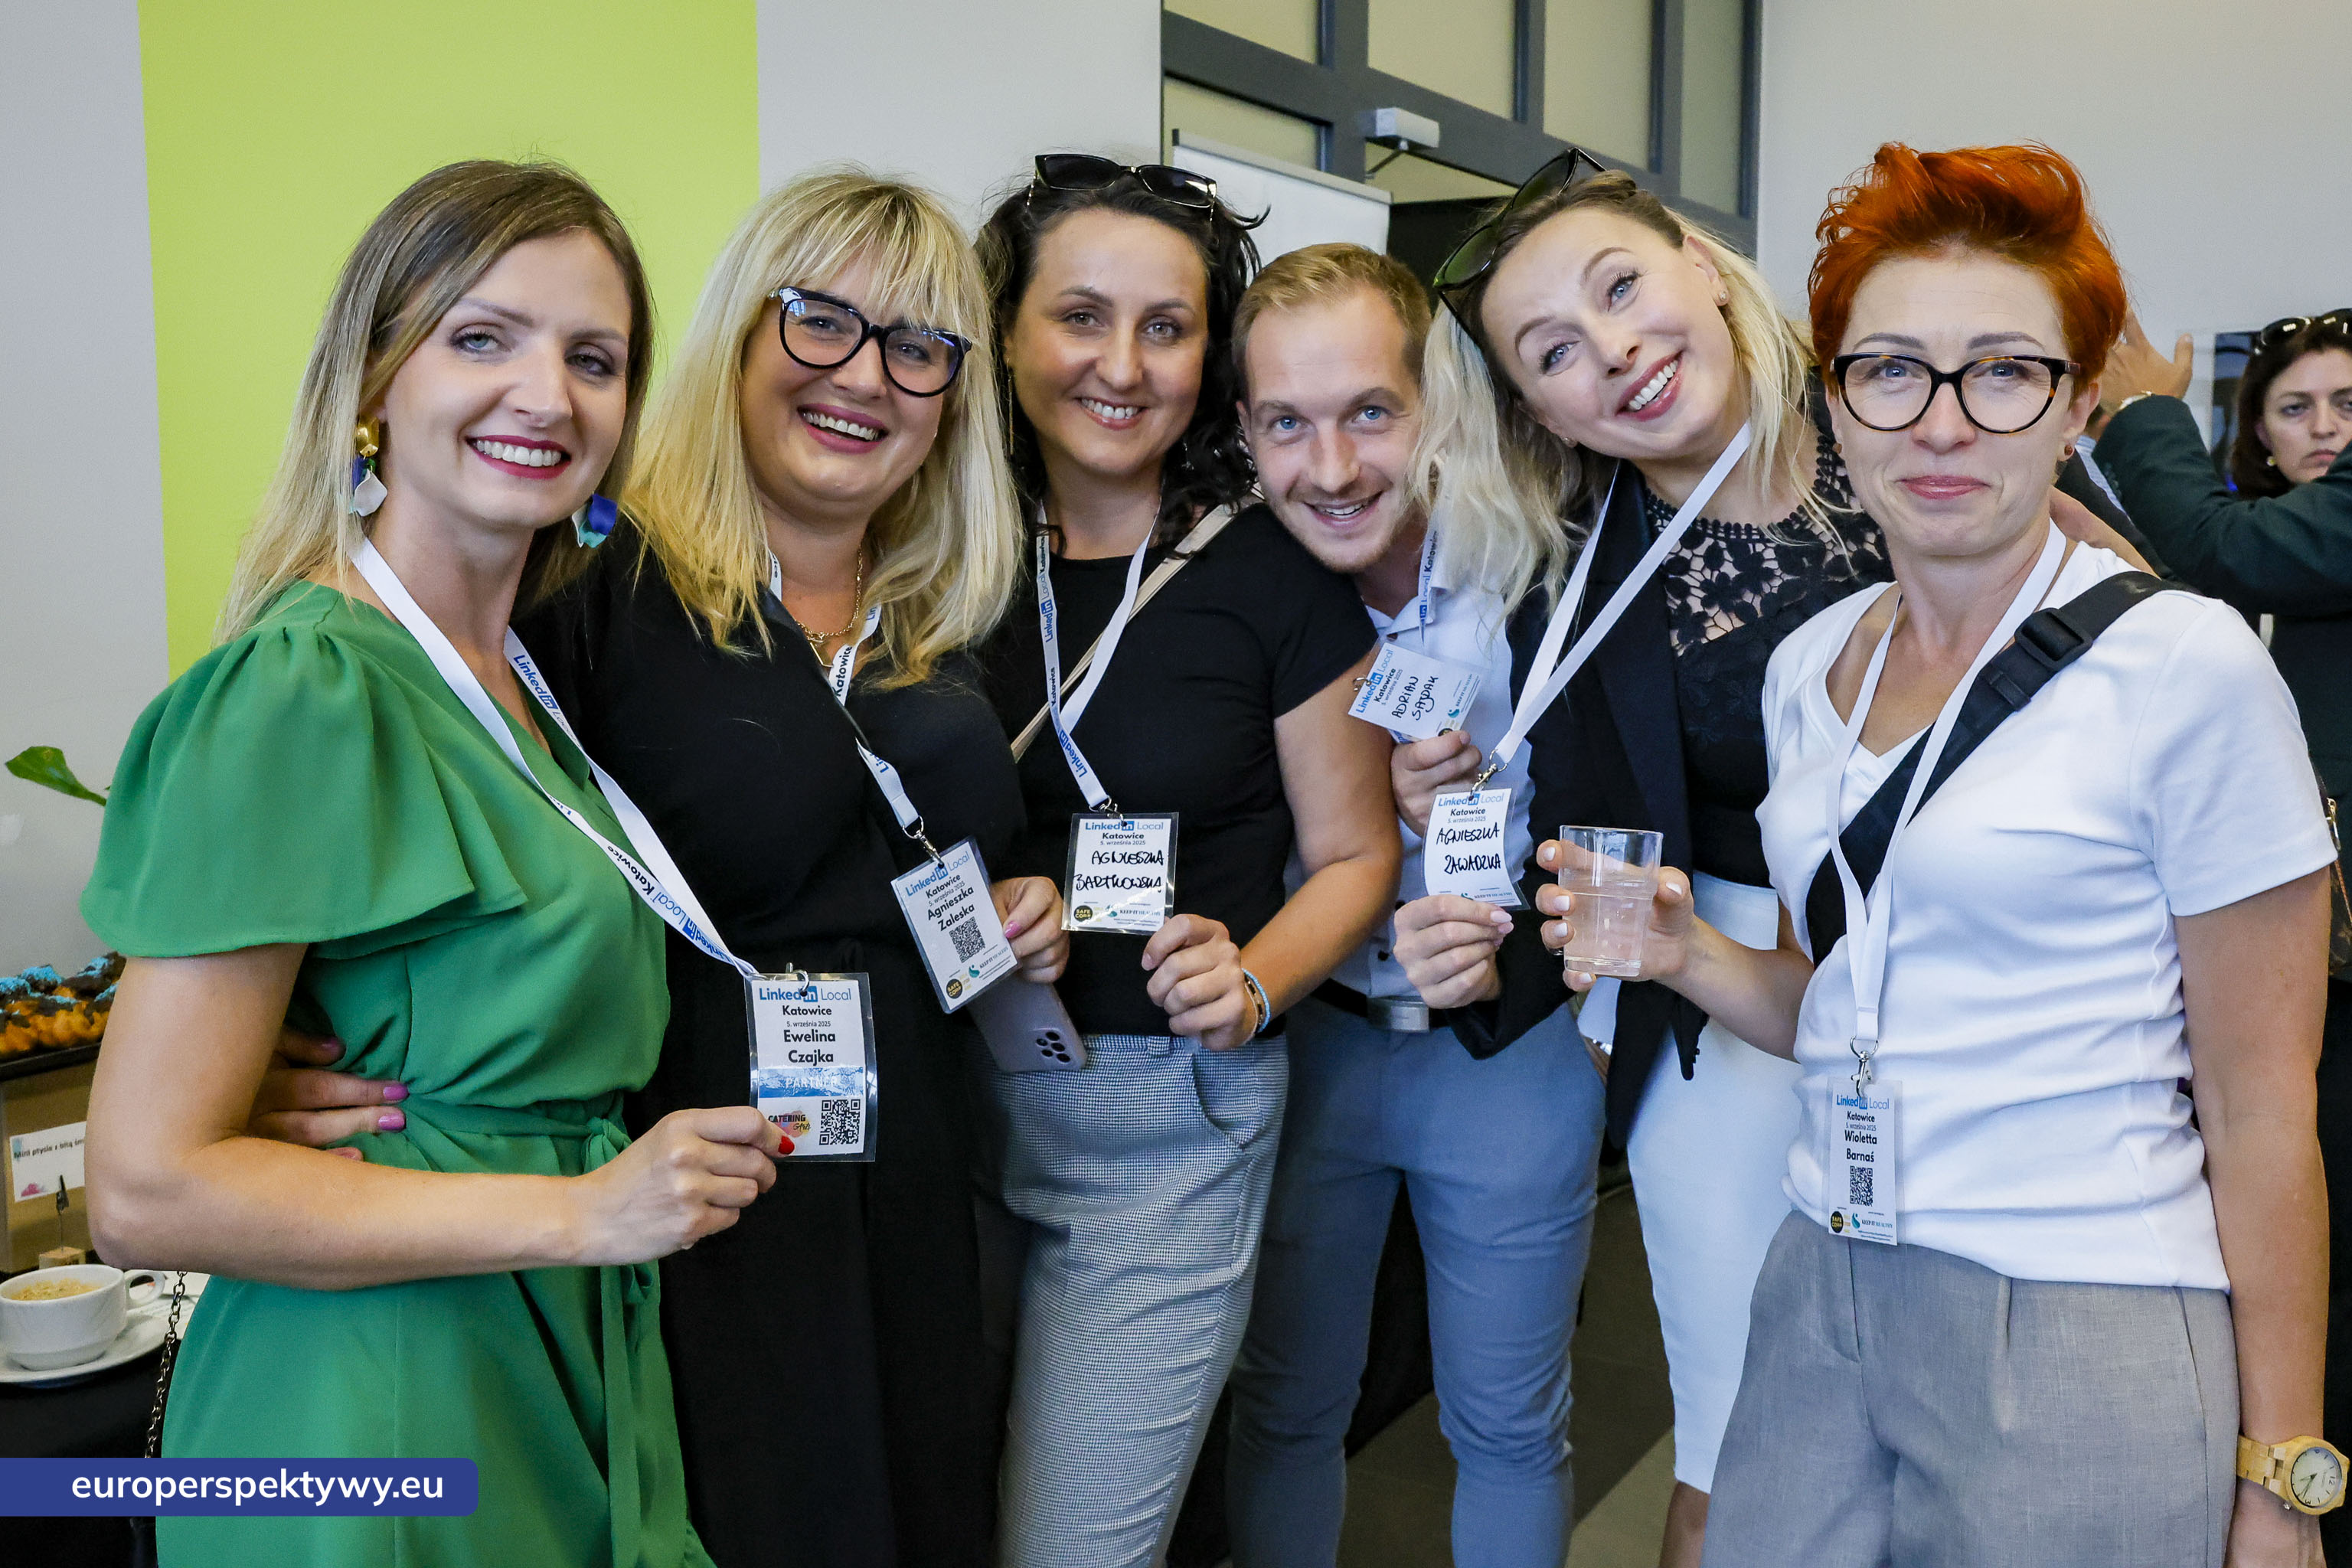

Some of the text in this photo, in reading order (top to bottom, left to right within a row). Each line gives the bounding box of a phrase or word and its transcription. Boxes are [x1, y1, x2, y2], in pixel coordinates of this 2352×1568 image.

[1424, 531, 1437, 573] Katowi
[1039, 573, 1050, 600] Local
[1040, 599, 1054, 643] Linkedin
[514, 655, 558, 709] Linkedin
[832, 646, 852, 697] Katowice
[1356, 649, 1393, 713] Linkedin Local
[1374, 668, 1396, 703] Katowice
[1392, 676, 1419, 718] ADRIAN
[1059, 730, 1088, 778] Linkedin
[1438, 792, 1504, 807] Linkedin Local
[1450, 807, 1486, 816] Katowice
[1085, 821, 1135, 831] Linkedin
[1436, 822, 1500, 845] AGNIESZKA
[607, 845, 655, 895] Katowice
[1091, 850, 1164, 866] AGNIESZKA
[1444, 853, 1501, 874] ZAWADZKA
[904, 851, 971, 897] Linkedin Local
[925, 873, 962, 900] Katowice
[926, 886, 975, 921] Agnieszka
[933, 887, 955, 906] września
[953, 880, 965, 891] 2025
[652, 892, 685, 925] Local
[937, 903, 975, 932] Zaleska
[759, 986, 851, 1002] Linkedin Local
[782, 1004, 832, 1016] Katowice
[783, 1029, 836, 1043] Ewelina
[788, 1050, 834, 1067] Czajka
[1837, 1094, 1889, 1109] Linkedin Local
[768, 1114, 806, 1123] CATERING
[1847, 1110, 1875, 1122] Katowice
[1844, 1130, 1877, 1145] Wioletta
[1847, 1148, 1874, 1162] Barnaś
